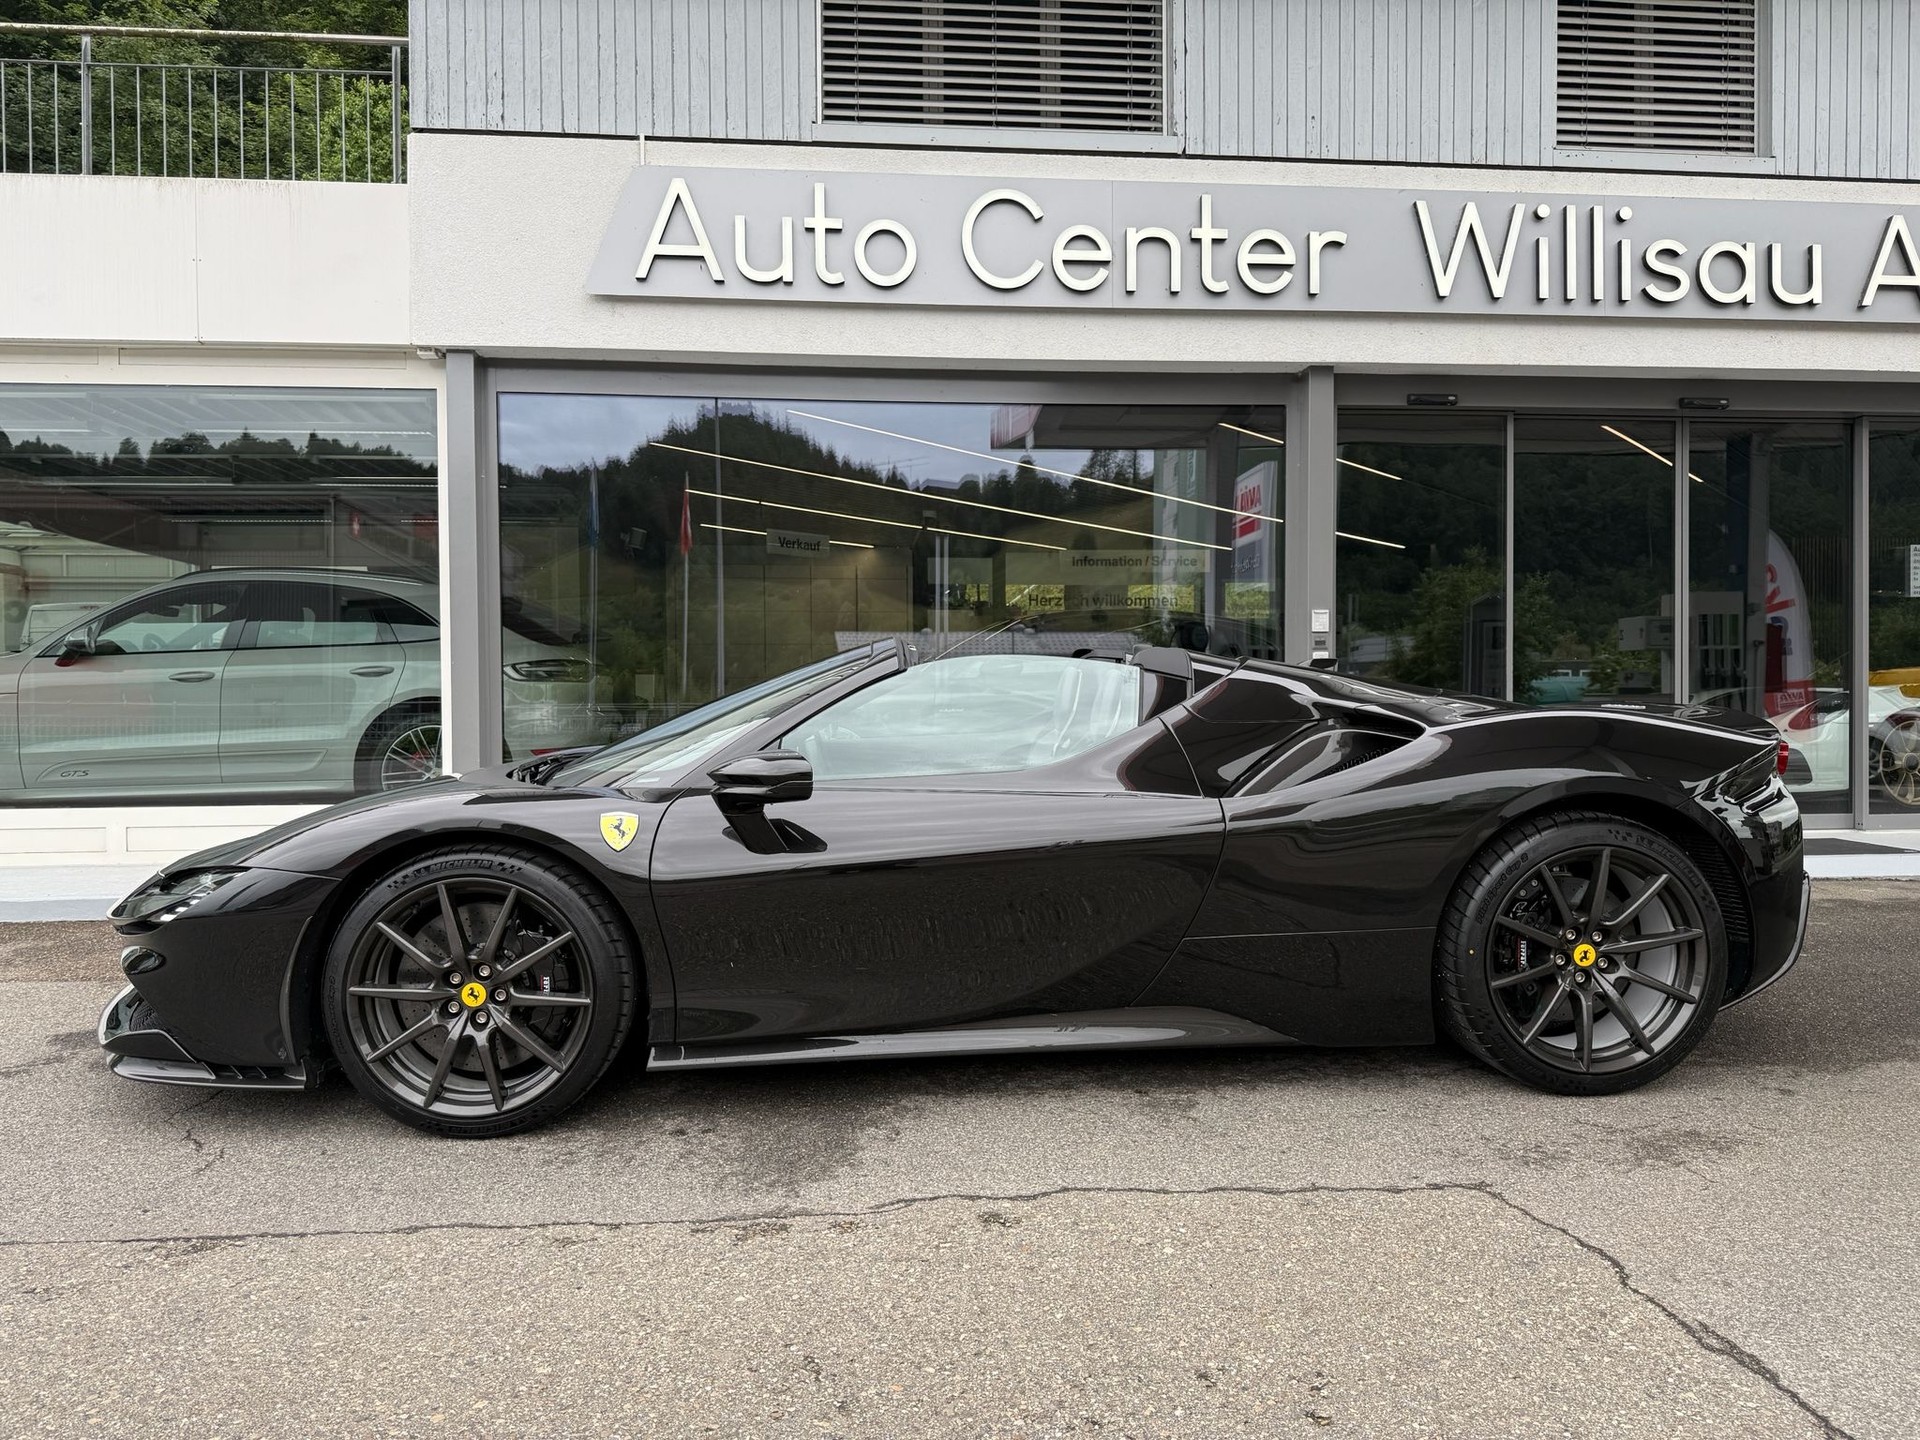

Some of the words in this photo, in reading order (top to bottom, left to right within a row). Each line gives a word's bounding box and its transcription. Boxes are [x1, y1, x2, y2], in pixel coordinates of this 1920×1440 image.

[635, 176, 917, 288] Auto
[960, 187, 1349, 296] Center
[1413, 199, 1823, 305] Willisau
[777, 536, 822, 552] Verkauf
[1071, 555, 1143, 567] Information
[1144, 556, 1150, 567] /
[1151, 556, 1198, 567] Service
[1091, 594, 1179, 607] willkommen
[60, 769, 90, 778] GTS
[430, 859, 494, 875] MICHELIN
[1505, 860, 1522, 876] Cup
